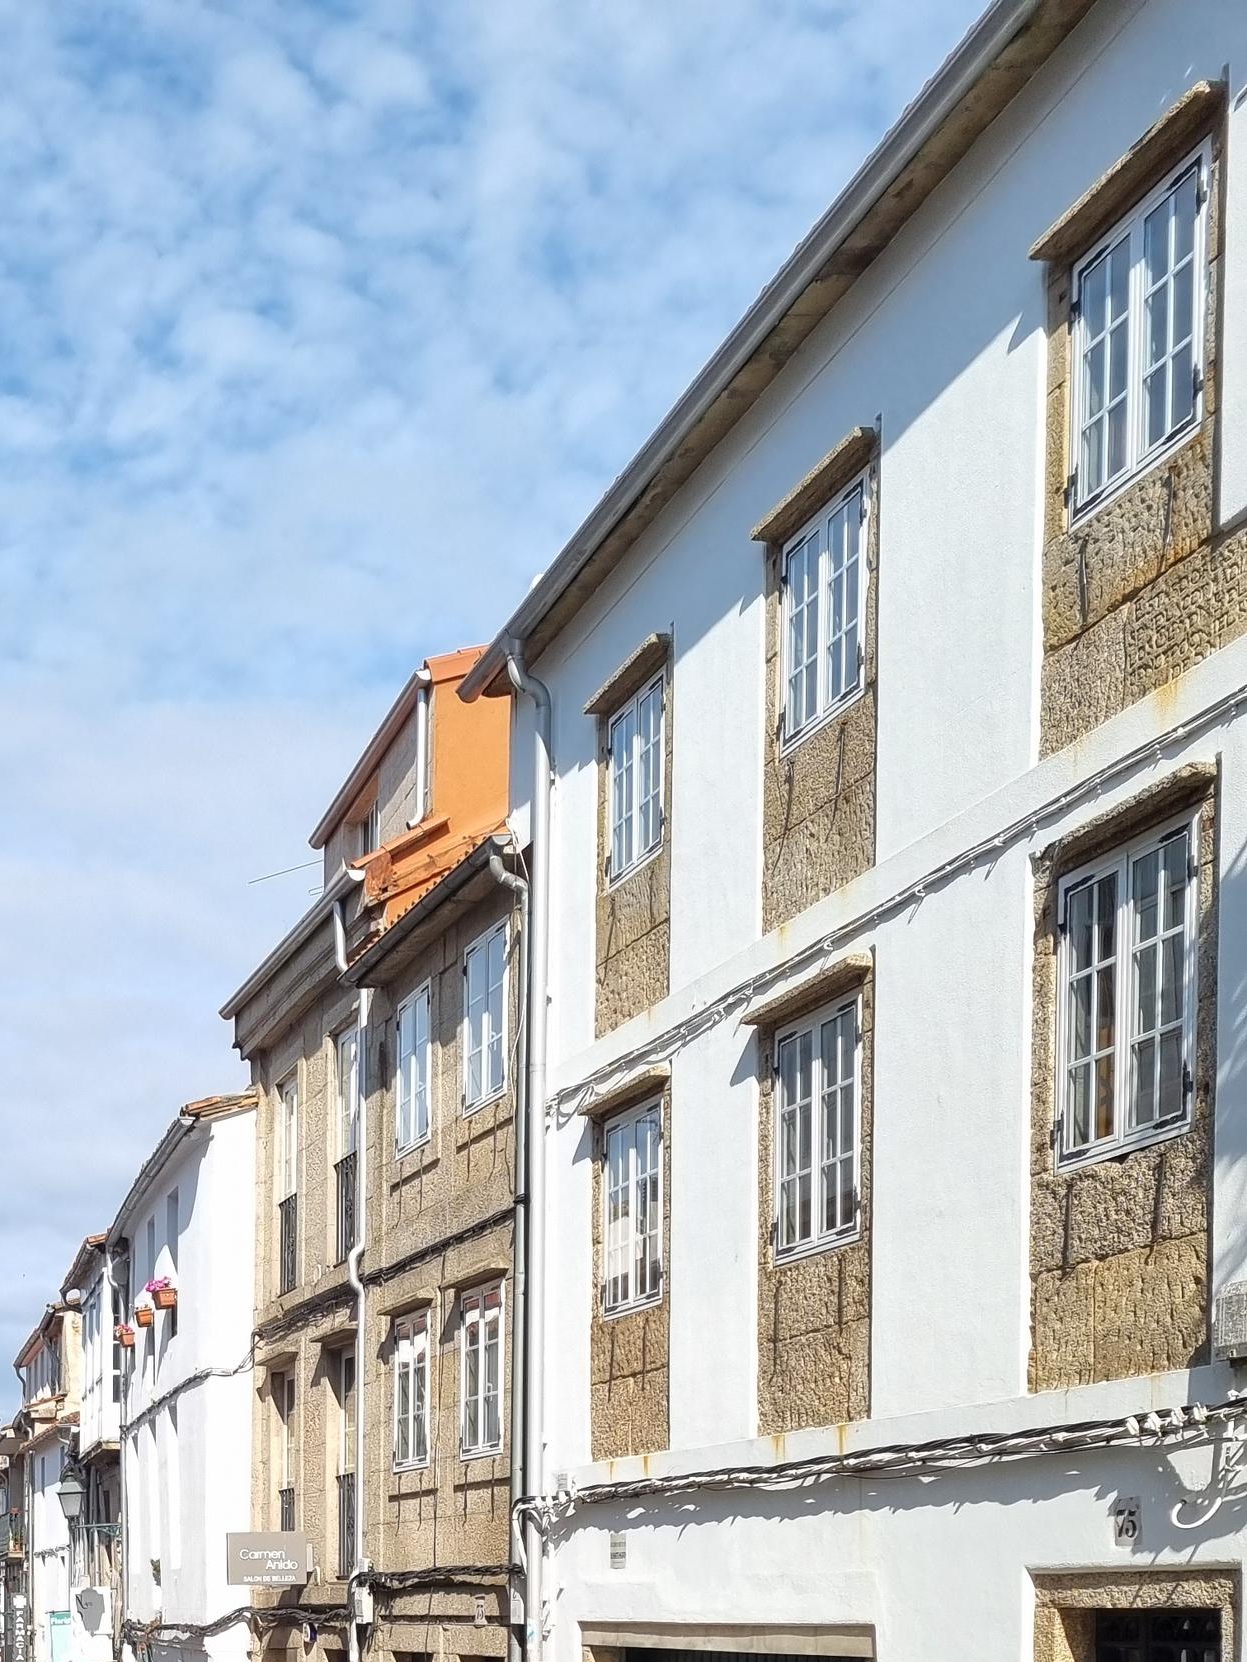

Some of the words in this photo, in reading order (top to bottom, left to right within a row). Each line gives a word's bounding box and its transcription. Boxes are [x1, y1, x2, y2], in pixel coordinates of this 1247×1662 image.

[1116, 1509, 1137, 1538] 75
[239, 1548, 286, 1560] Carmen
[265, 1559, 299, 1570] Anido
[15, 1610, 26, 1661] FARMACIA
